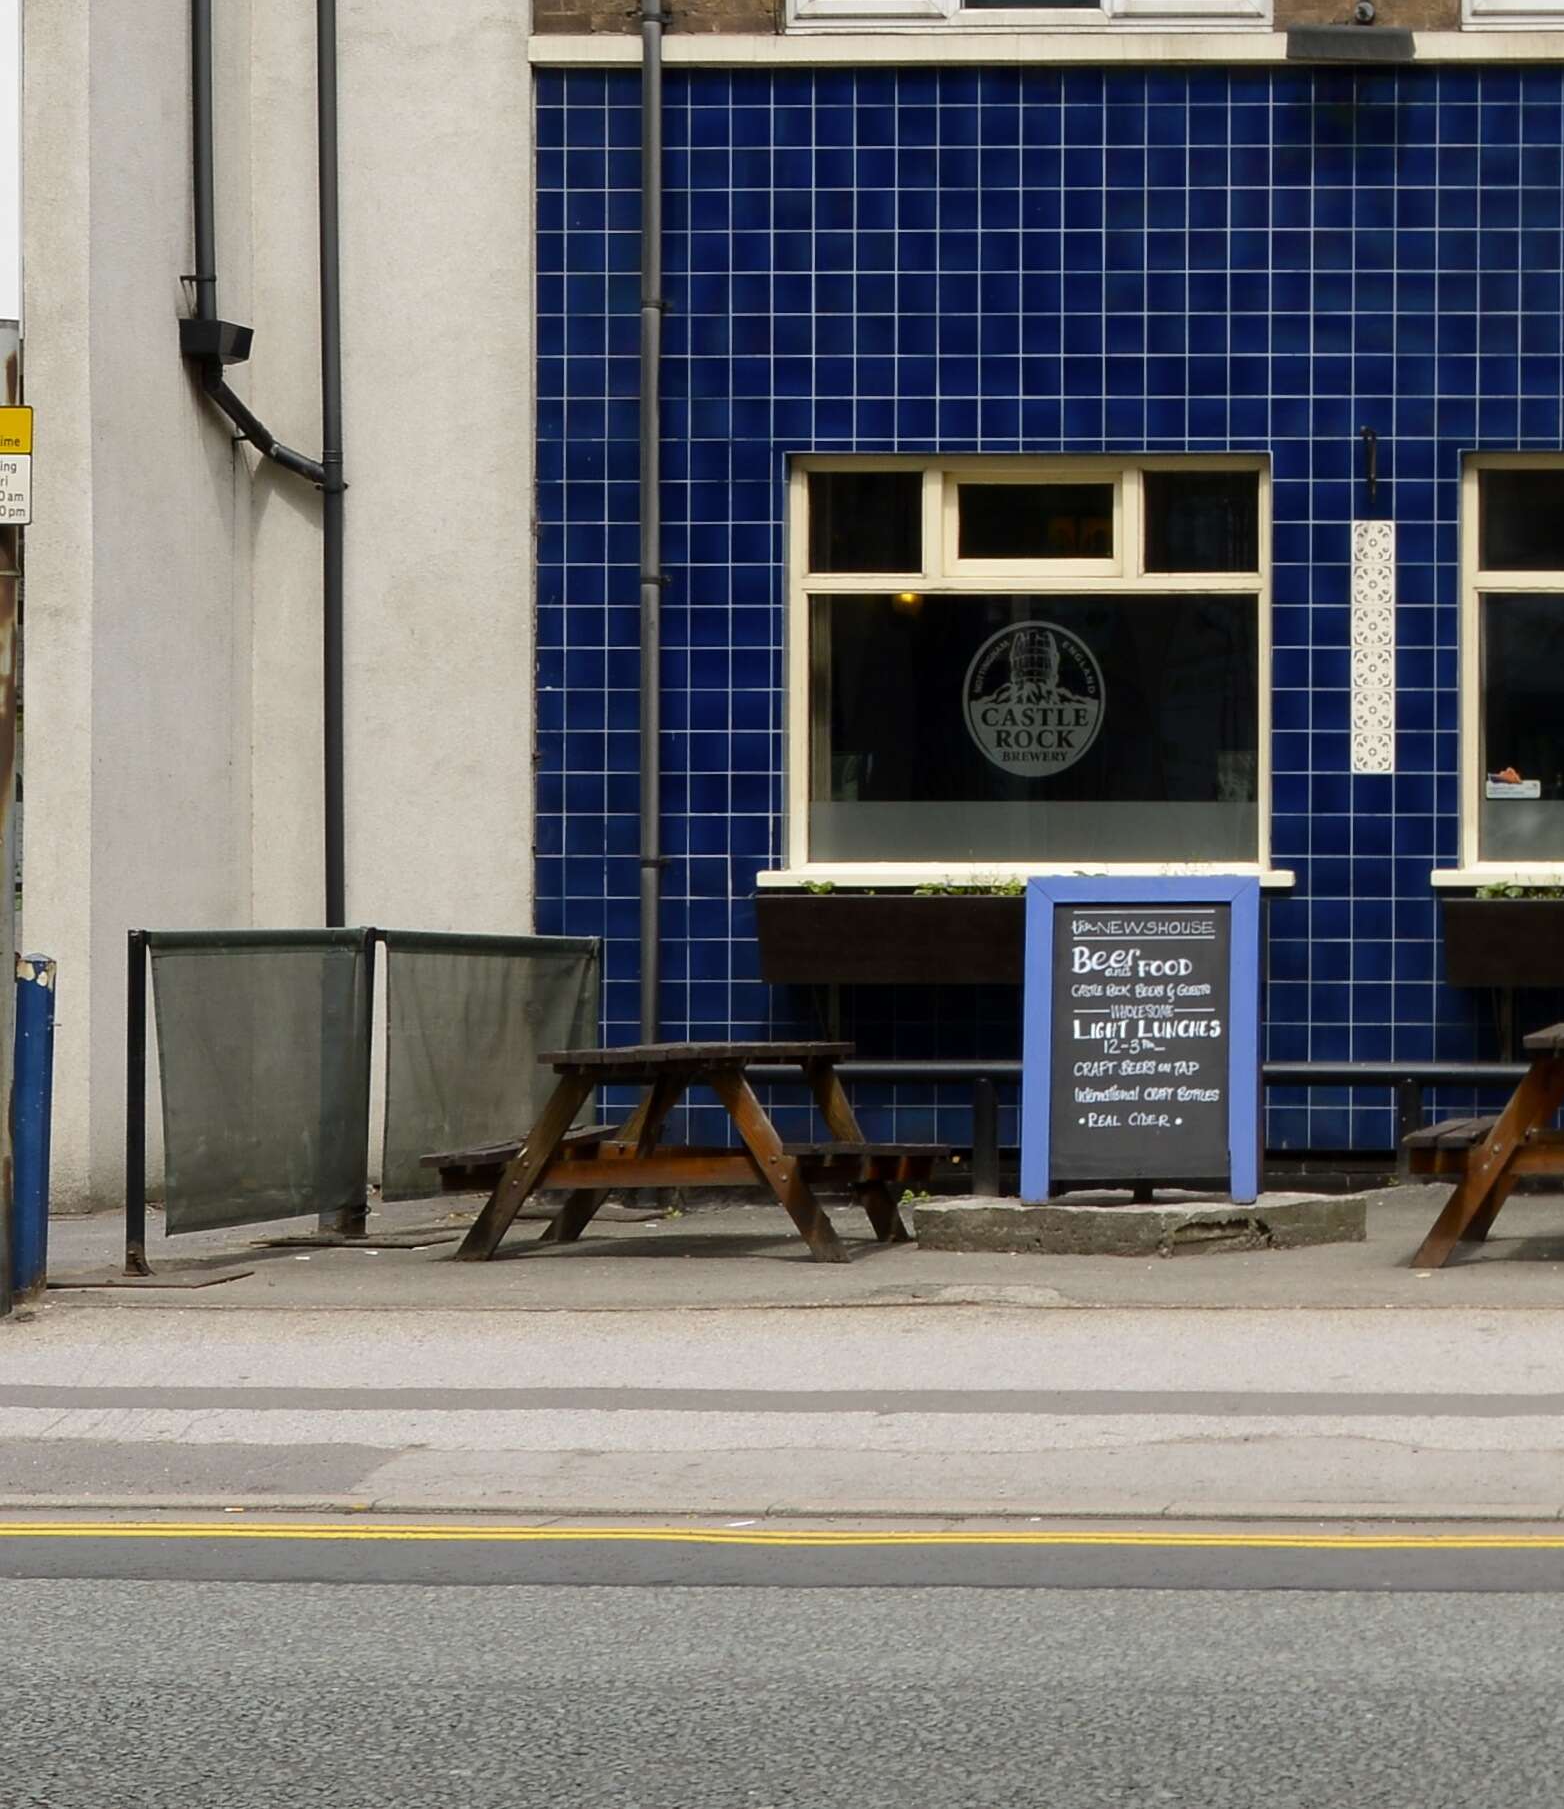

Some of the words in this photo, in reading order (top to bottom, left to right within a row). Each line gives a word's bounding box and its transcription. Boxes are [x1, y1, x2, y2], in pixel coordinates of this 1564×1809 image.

[1061, 640, 1096, 695] ENGLAND
[981, 707, 1088, 727] CASTLE
[996, 730, 1075, 749] ROCK
[1002, 750, 1068, 762] BREWERY
[1098, 920, 1216, 935] NEWSHOUSE
[1071, 945, 1140, 975] Beer
[1138, 958, 1193, 977] FOOD
[1110, 1003, 1175, 1019] WHOLESOME
[1073, 1019, 1129, 1040] LIGHT
[1137, 1019, 1222, 1039] LUNCHES
[1073, 1061, 1117, 1077] CRAFT
[1119, 1060, 1156, 1076] BEERS
[1173, 1062, 1200, 1076] TAP
[1087, 1112, 1121, 1128] REAL
[1127, 1112, 1171, 1127] CIDER
